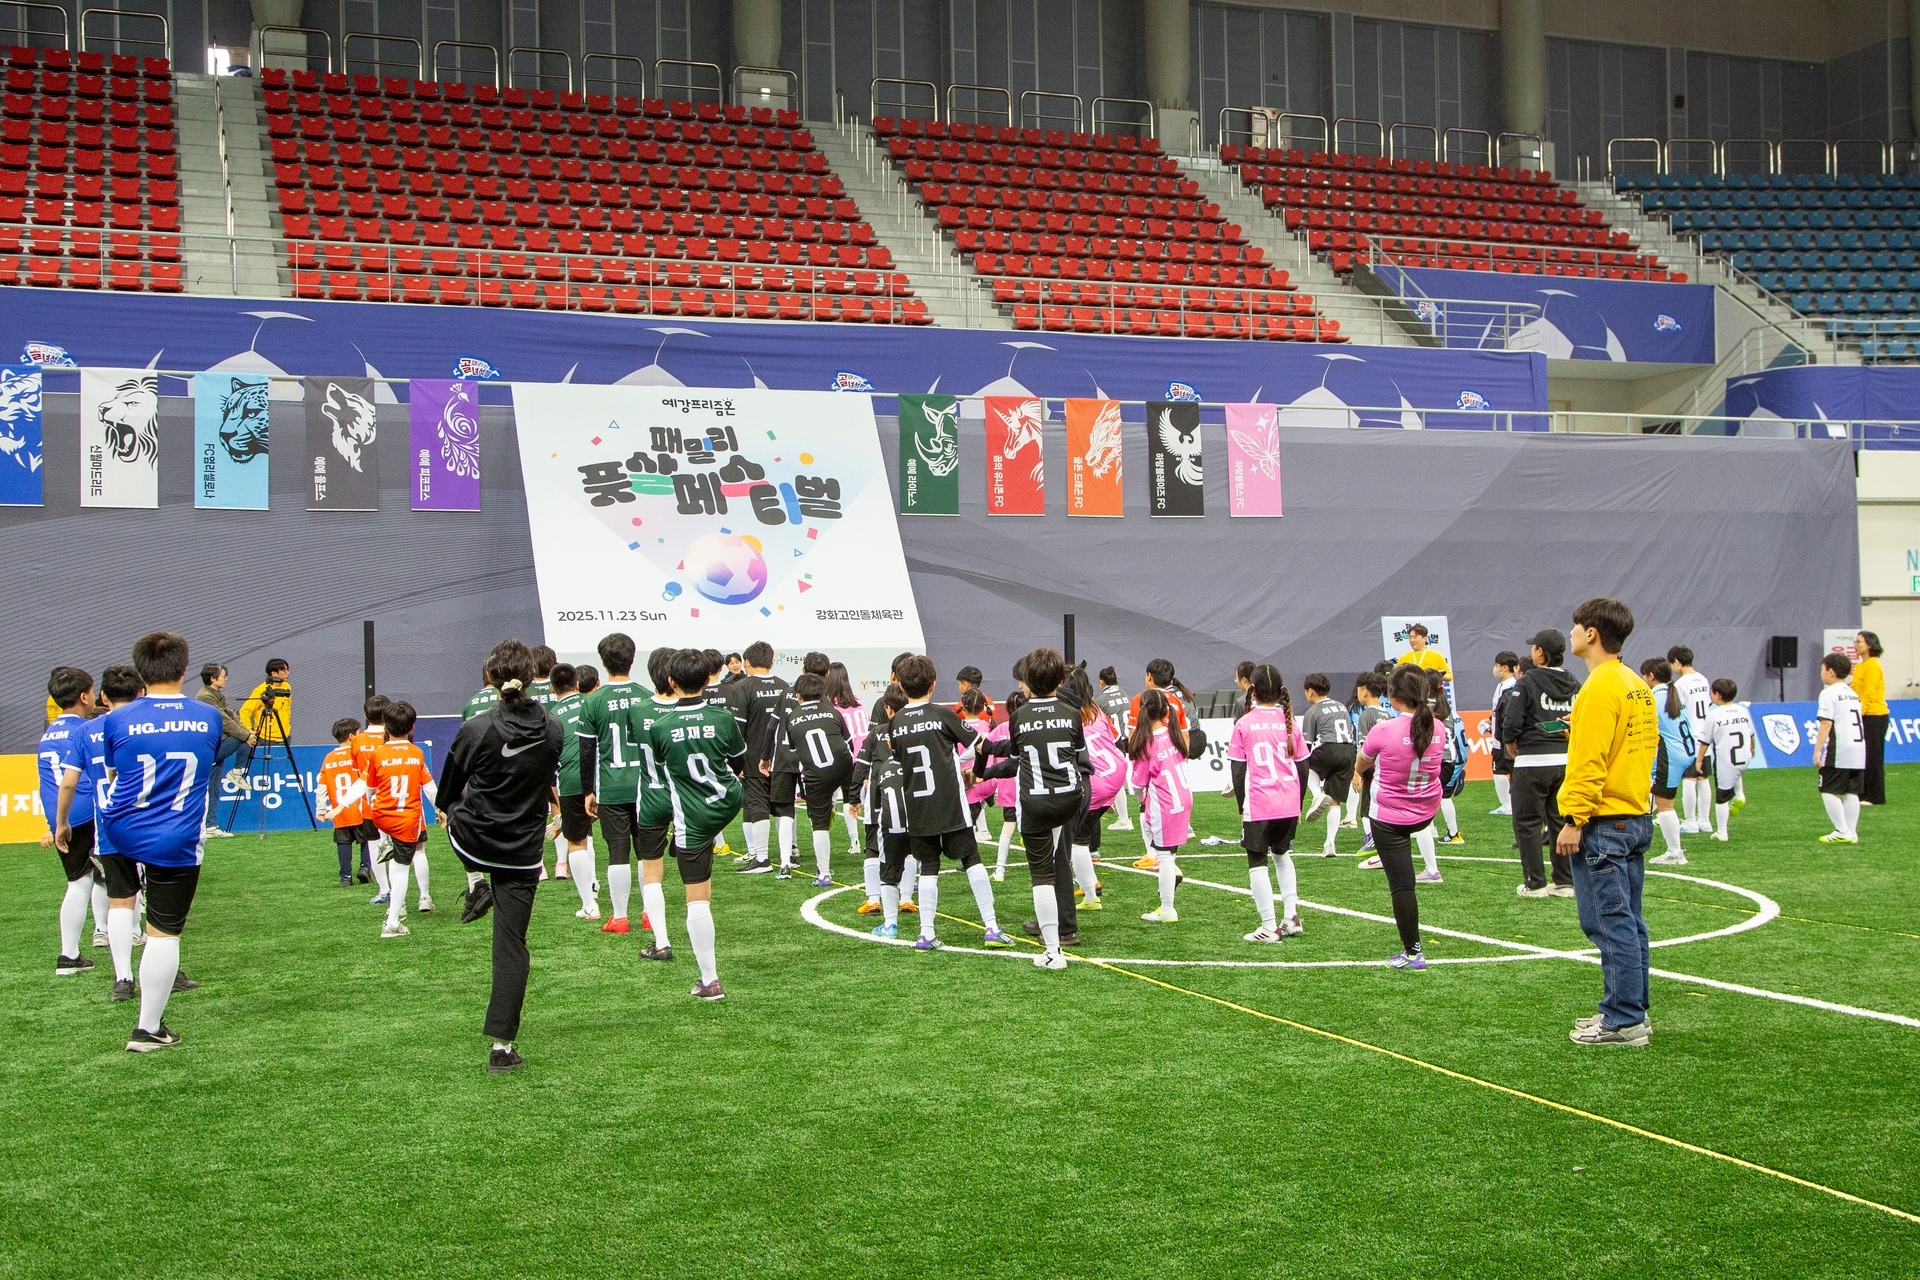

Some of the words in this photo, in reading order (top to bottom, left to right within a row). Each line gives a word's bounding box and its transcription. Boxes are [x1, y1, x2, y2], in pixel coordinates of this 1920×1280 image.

[661, 397, 736, 416] 예강프리즘온
[649, 426, 739, 465] 패밀리
[314, 456, 326, 473] 예예
[419, 449, 430, 466] 예예
[907, 459, 917, 474] 예예
[993, 455, 1003, 470] 꿈의
[1073, 456, 1083, 471] 골든
[90, 445, 102, 497] 신월마드리드
[314, 475, 327, 501] 울프스
[419, 468, 431, 501] 피코크스
[907, 476, 918, 506] 라이노스
[994, 473, 1004, 494] 유니콘
[1074, 474, 1084, 496] 드래곤
[995, 496, 1005, 507] FC
[1074, 498, 1084, 508] FC
[1157, 498, 1166, 509] FC
[1236, 498, 1245, 509] FC
[557, 610, 638, 622] 2025.11.23
[639, 610, 668, 621] Sun
[815, 609, 904, 621] 강화고인돌체육관
[129, 721, 208, 735] HG.JUNG
[910, 721, 942, 734] JEON
[1020, 721, 1044, 734] M.C
[1046, 719, 1073, 729] KIM
[1850, 709, 1864, 742] 3
[805, 728, 835, 768] 0
[1679, 720, 1695, 757] 8
[1729, 731, 1745, 766] 2
[404, 757, 420, 766] JIN
[907, 745, 936, 797] 3
[1024, 741, 1077, 795] 15
[131, 752, 198, 811] 17
[687, 752, 728, 805] 9
[1407, 756, 1432, 794] 6
[390, 775, 409, 812] 4
